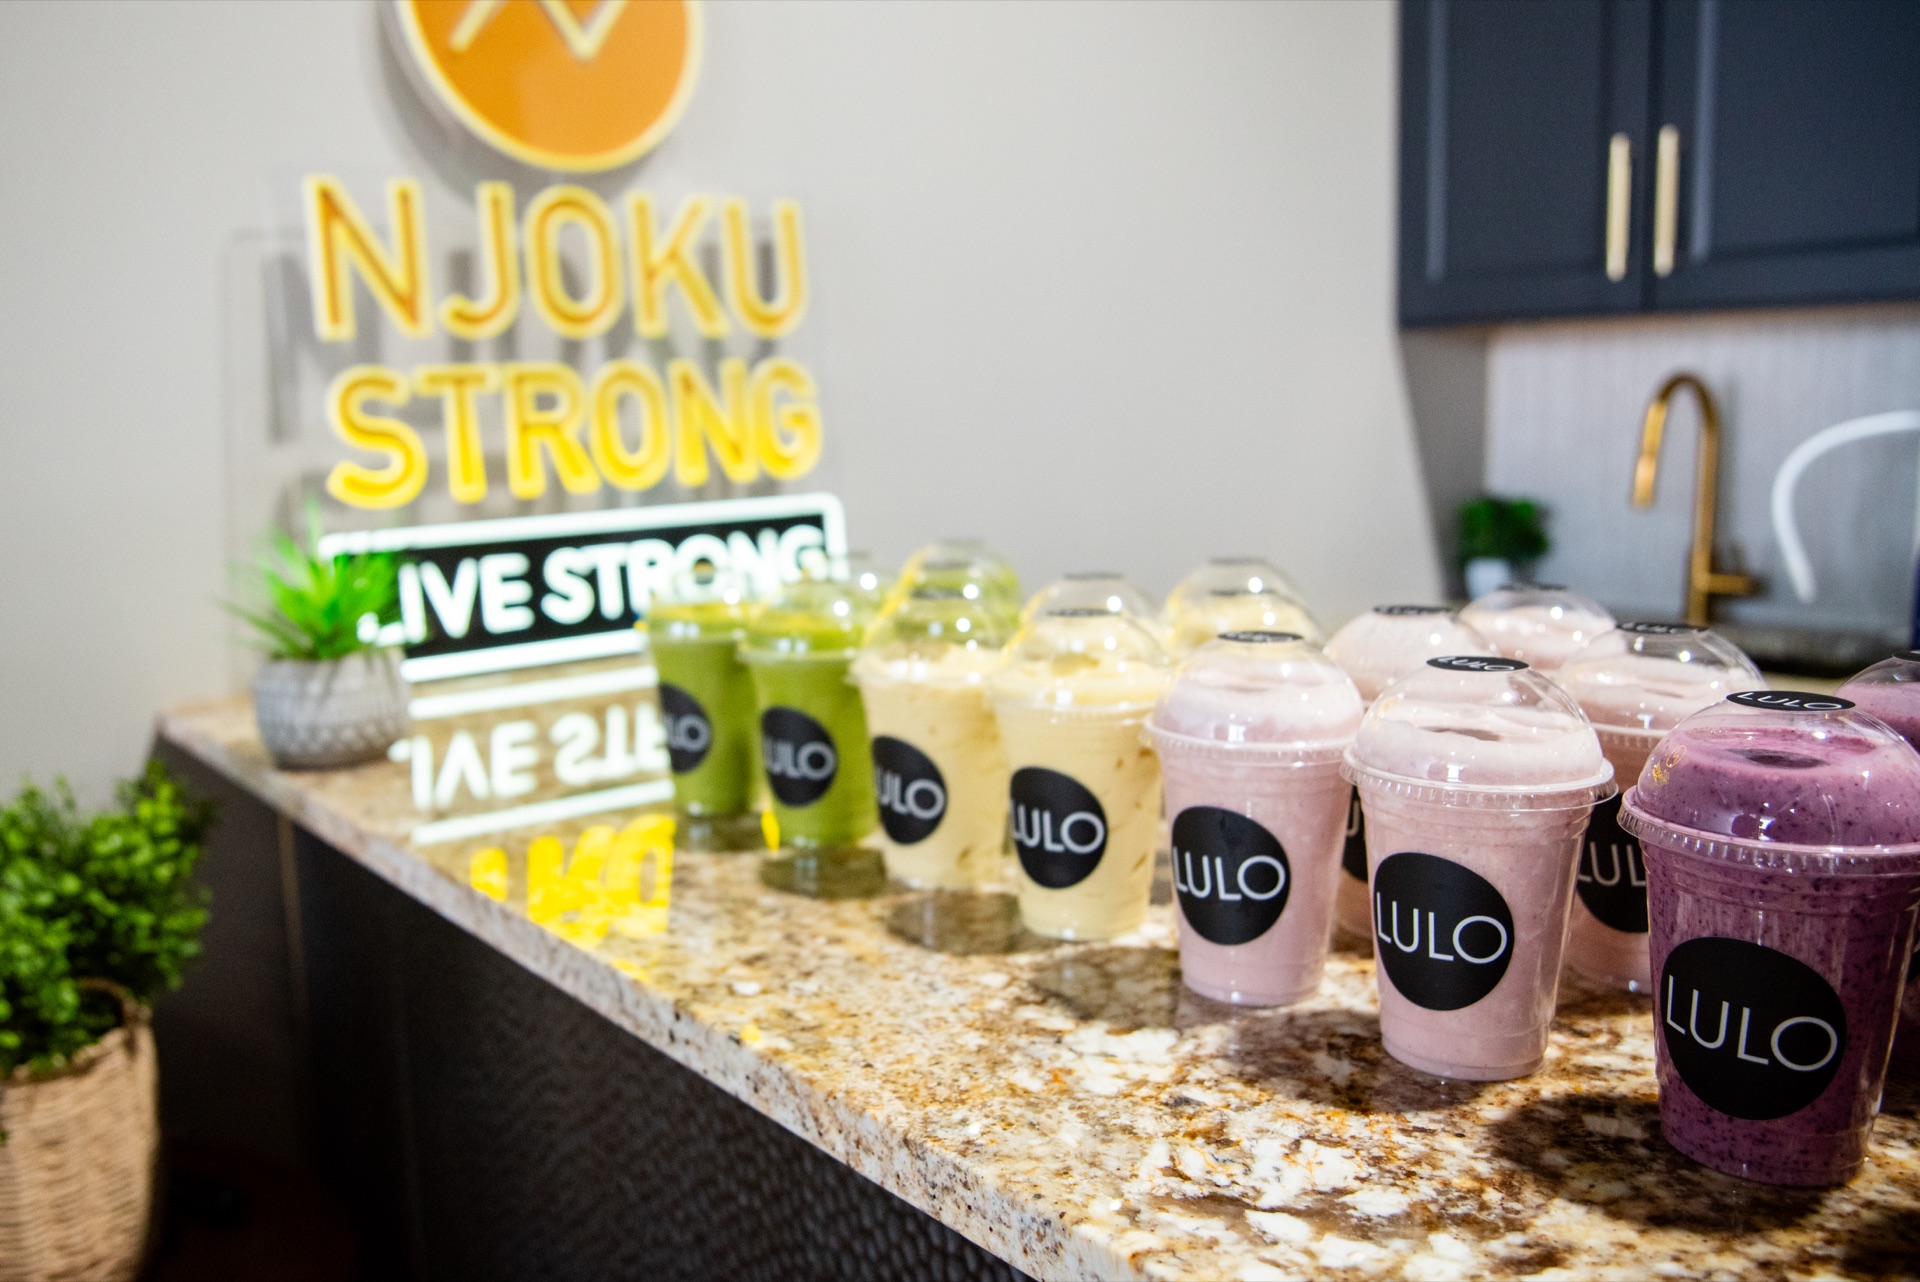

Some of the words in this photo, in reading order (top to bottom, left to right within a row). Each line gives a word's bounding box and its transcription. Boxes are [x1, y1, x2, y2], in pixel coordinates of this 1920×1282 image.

[306, 174, 810, 340] NJOKU
[325, 357, 824, 511] STRONG
[540, 524, 826, 625] STRONG
[1737, 691, 1842, 710] LULO
[1172, 846, 1286, 900] LULO
[1578, 841, 1646, 887] UL
[1375, 891, 1507, 964] LULO
[1665, 974, 1838, 1072] LULO
